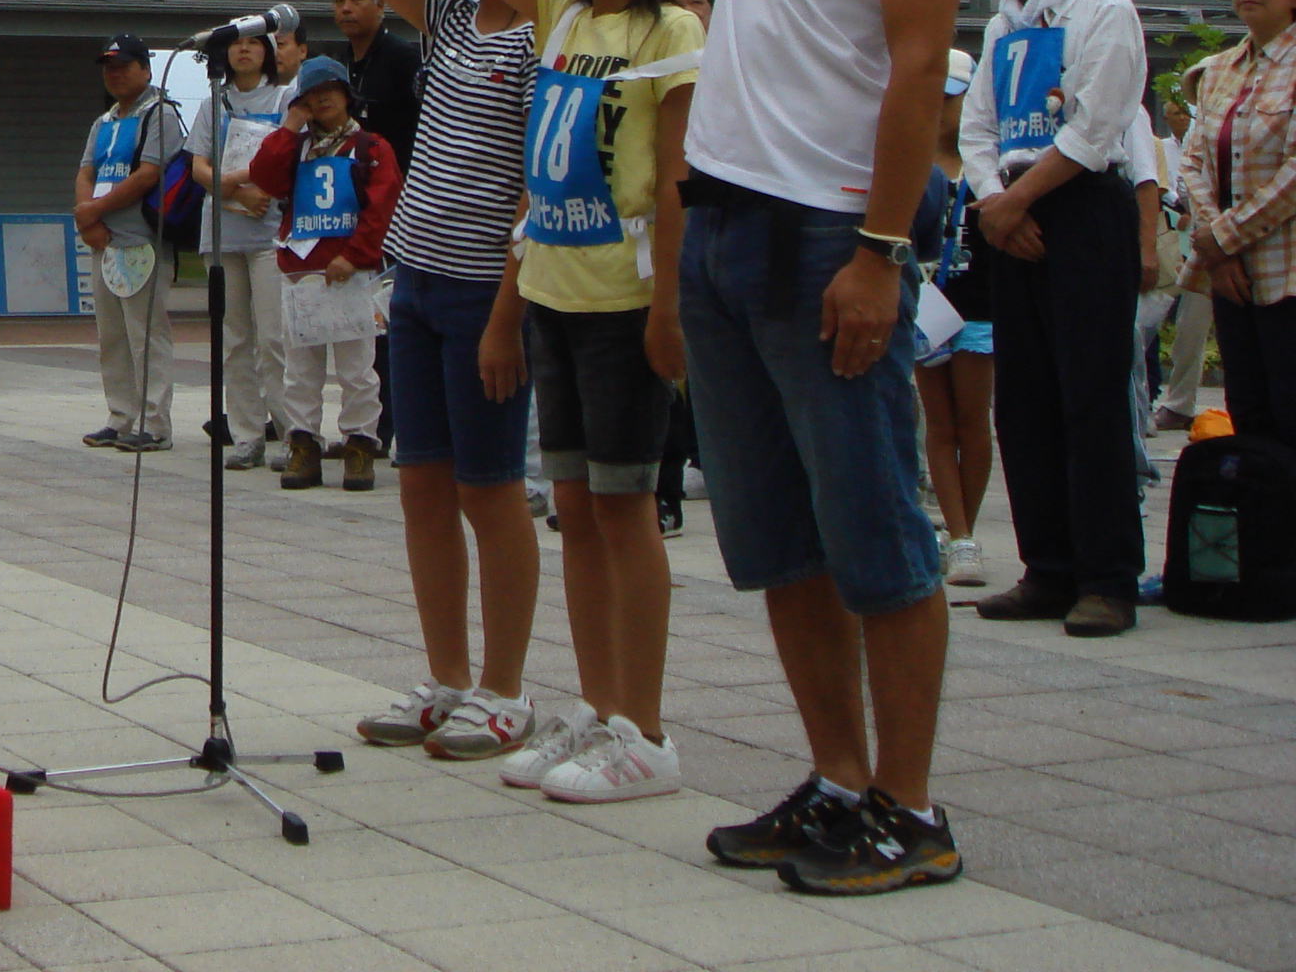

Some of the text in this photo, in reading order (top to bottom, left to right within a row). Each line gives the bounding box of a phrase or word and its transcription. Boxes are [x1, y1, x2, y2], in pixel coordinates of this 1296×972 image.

[1007, 40, 1027, 106] 7
[107, 122, 121, 158] 1
[533, 85, 581, 181] 18
[315, 165, 335, 209] 3
